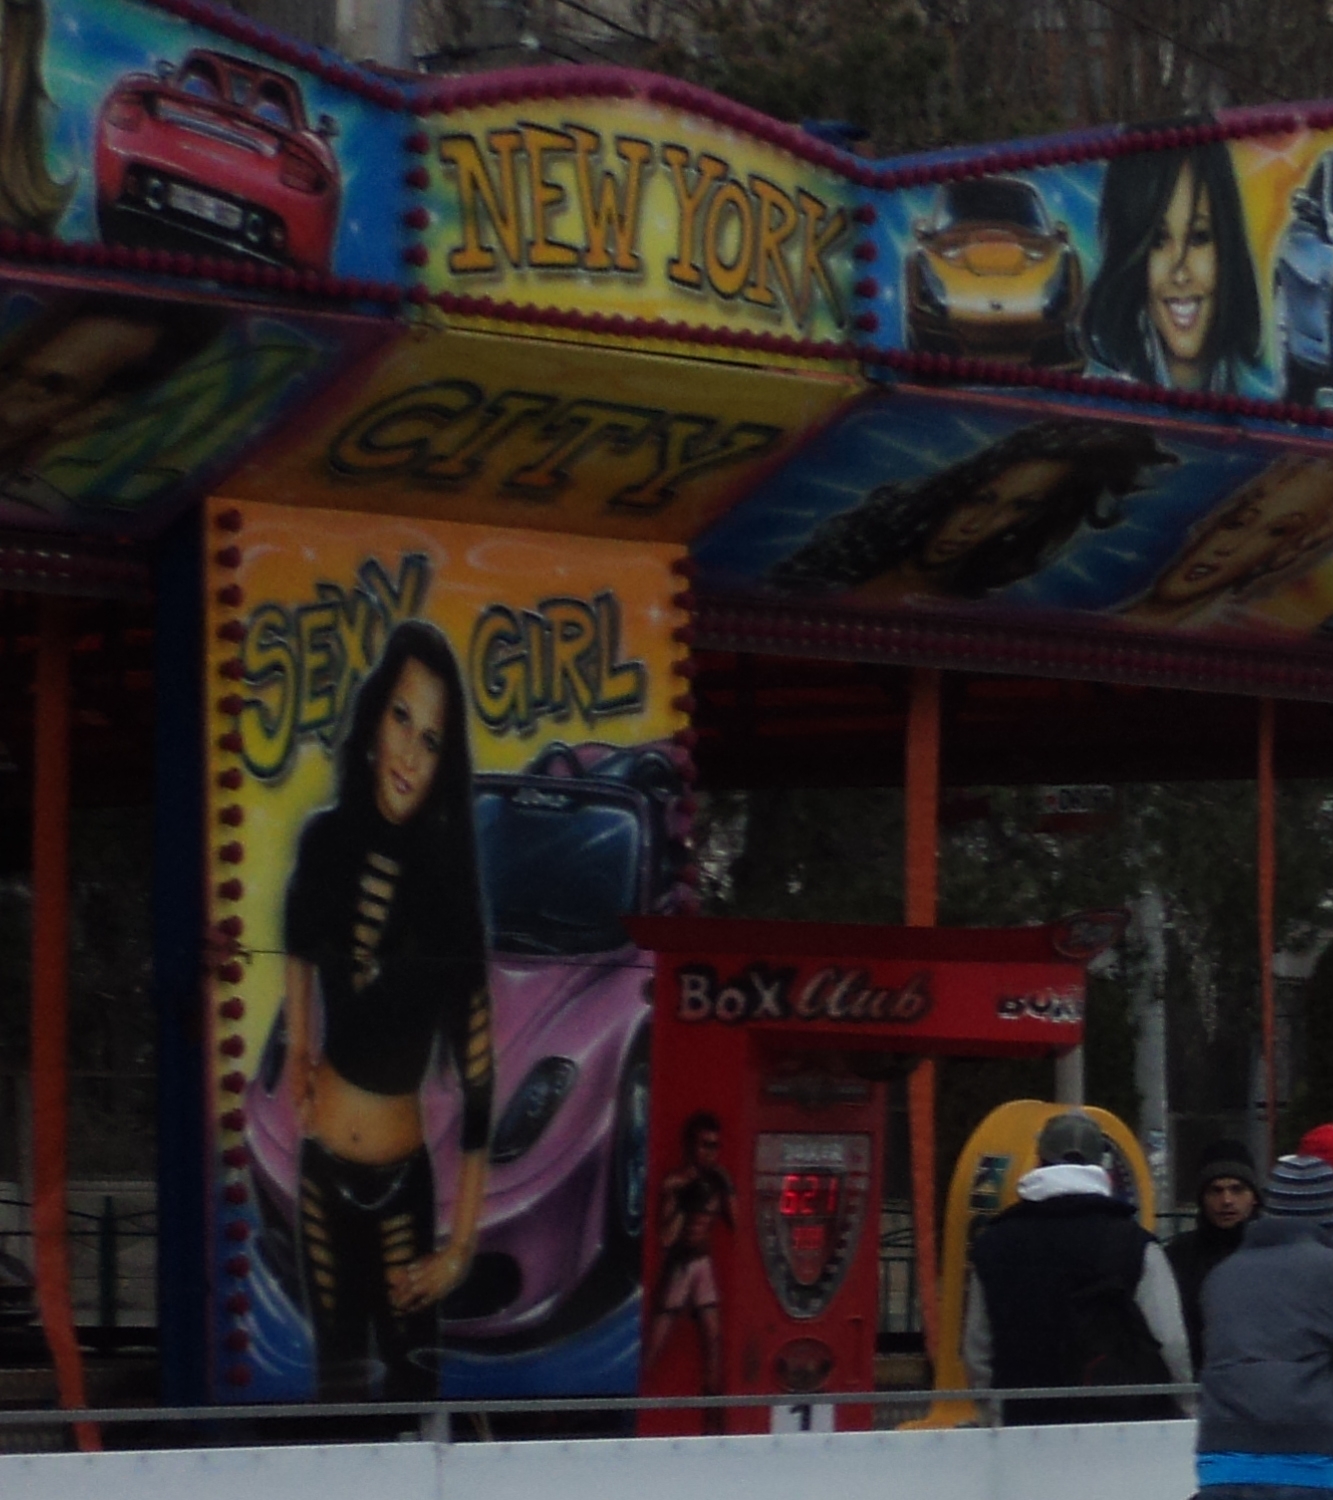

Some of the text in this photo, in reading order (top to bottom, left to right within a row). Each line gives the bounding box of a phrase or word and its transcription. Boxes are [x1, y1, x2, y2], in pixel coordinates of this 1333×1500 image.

[440, 120, 848, 330] NEW YORK
[327, 380, 783, 510] CITY
[237, 553, 650, 780] SEXY GIRL
